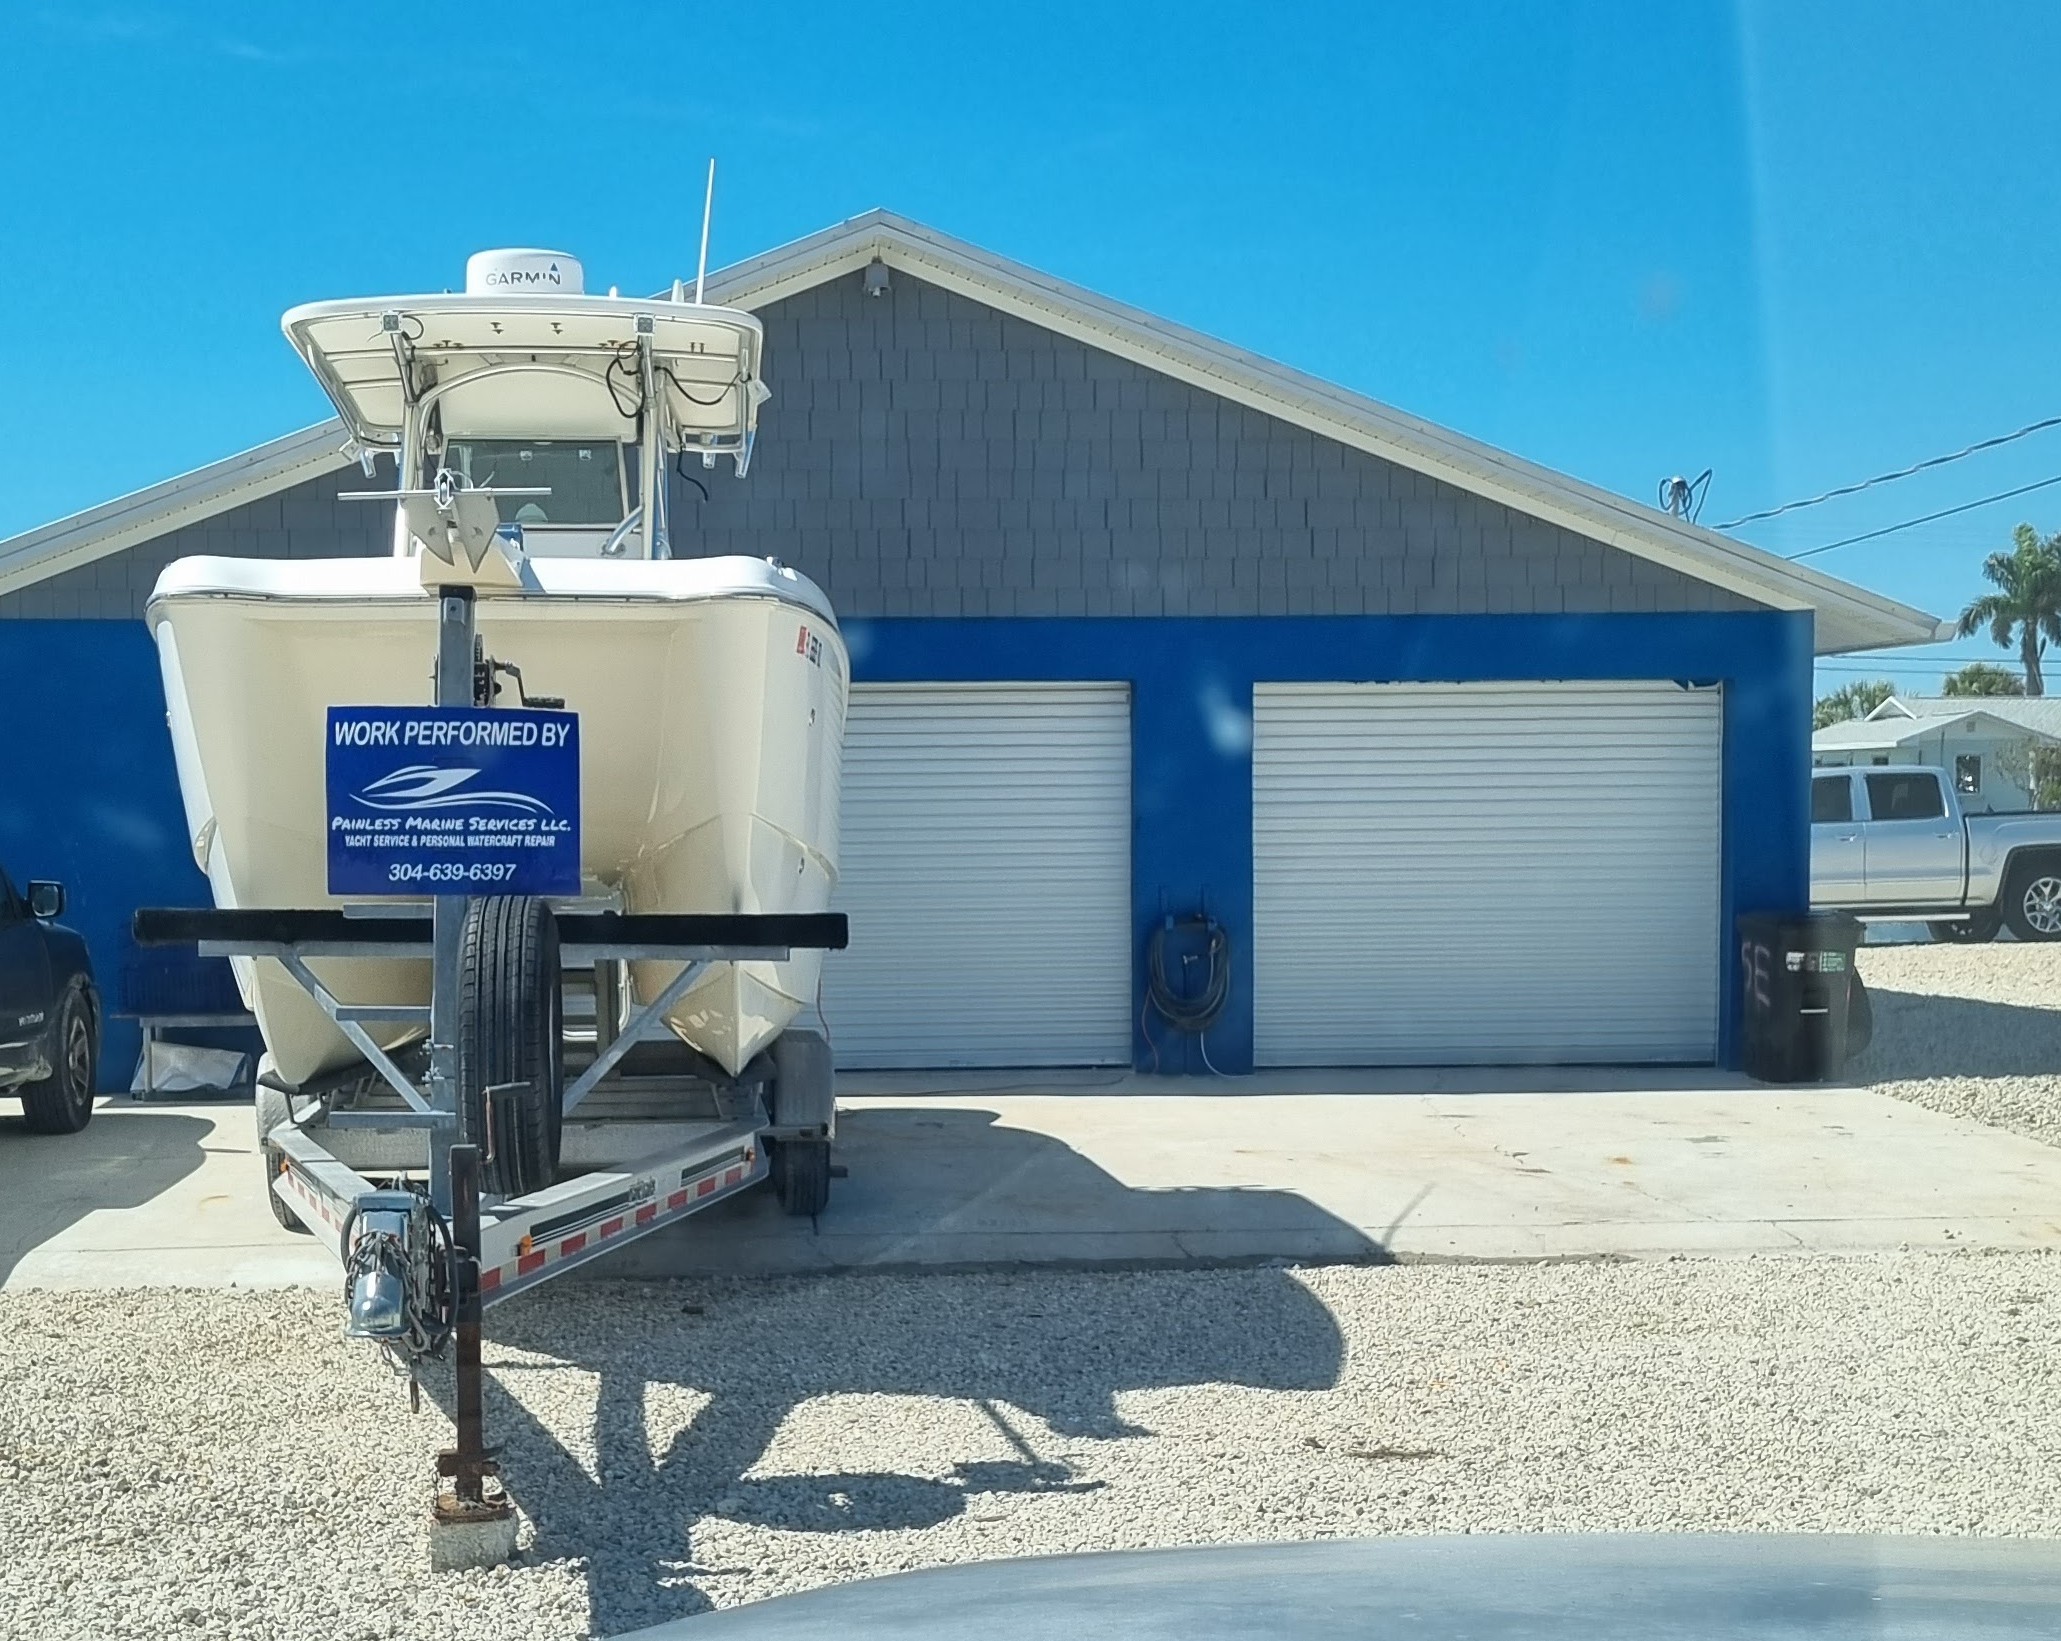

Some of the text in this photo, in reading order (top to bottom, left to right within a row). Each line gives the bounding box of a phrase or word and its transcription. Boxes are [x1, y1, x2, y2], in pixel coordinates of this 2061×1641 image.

[486, 271, 560, 285] GARMIN
[335, 721, 570, 747] WORK PERFORMED BY
[541, 819, 571, 832] LLC.
[345, 834, 555, 847] YACHT SERVICE & PERSONAL WATERCRAFT REPAIR
[388, 863, 517, 881] 304-639-6397
